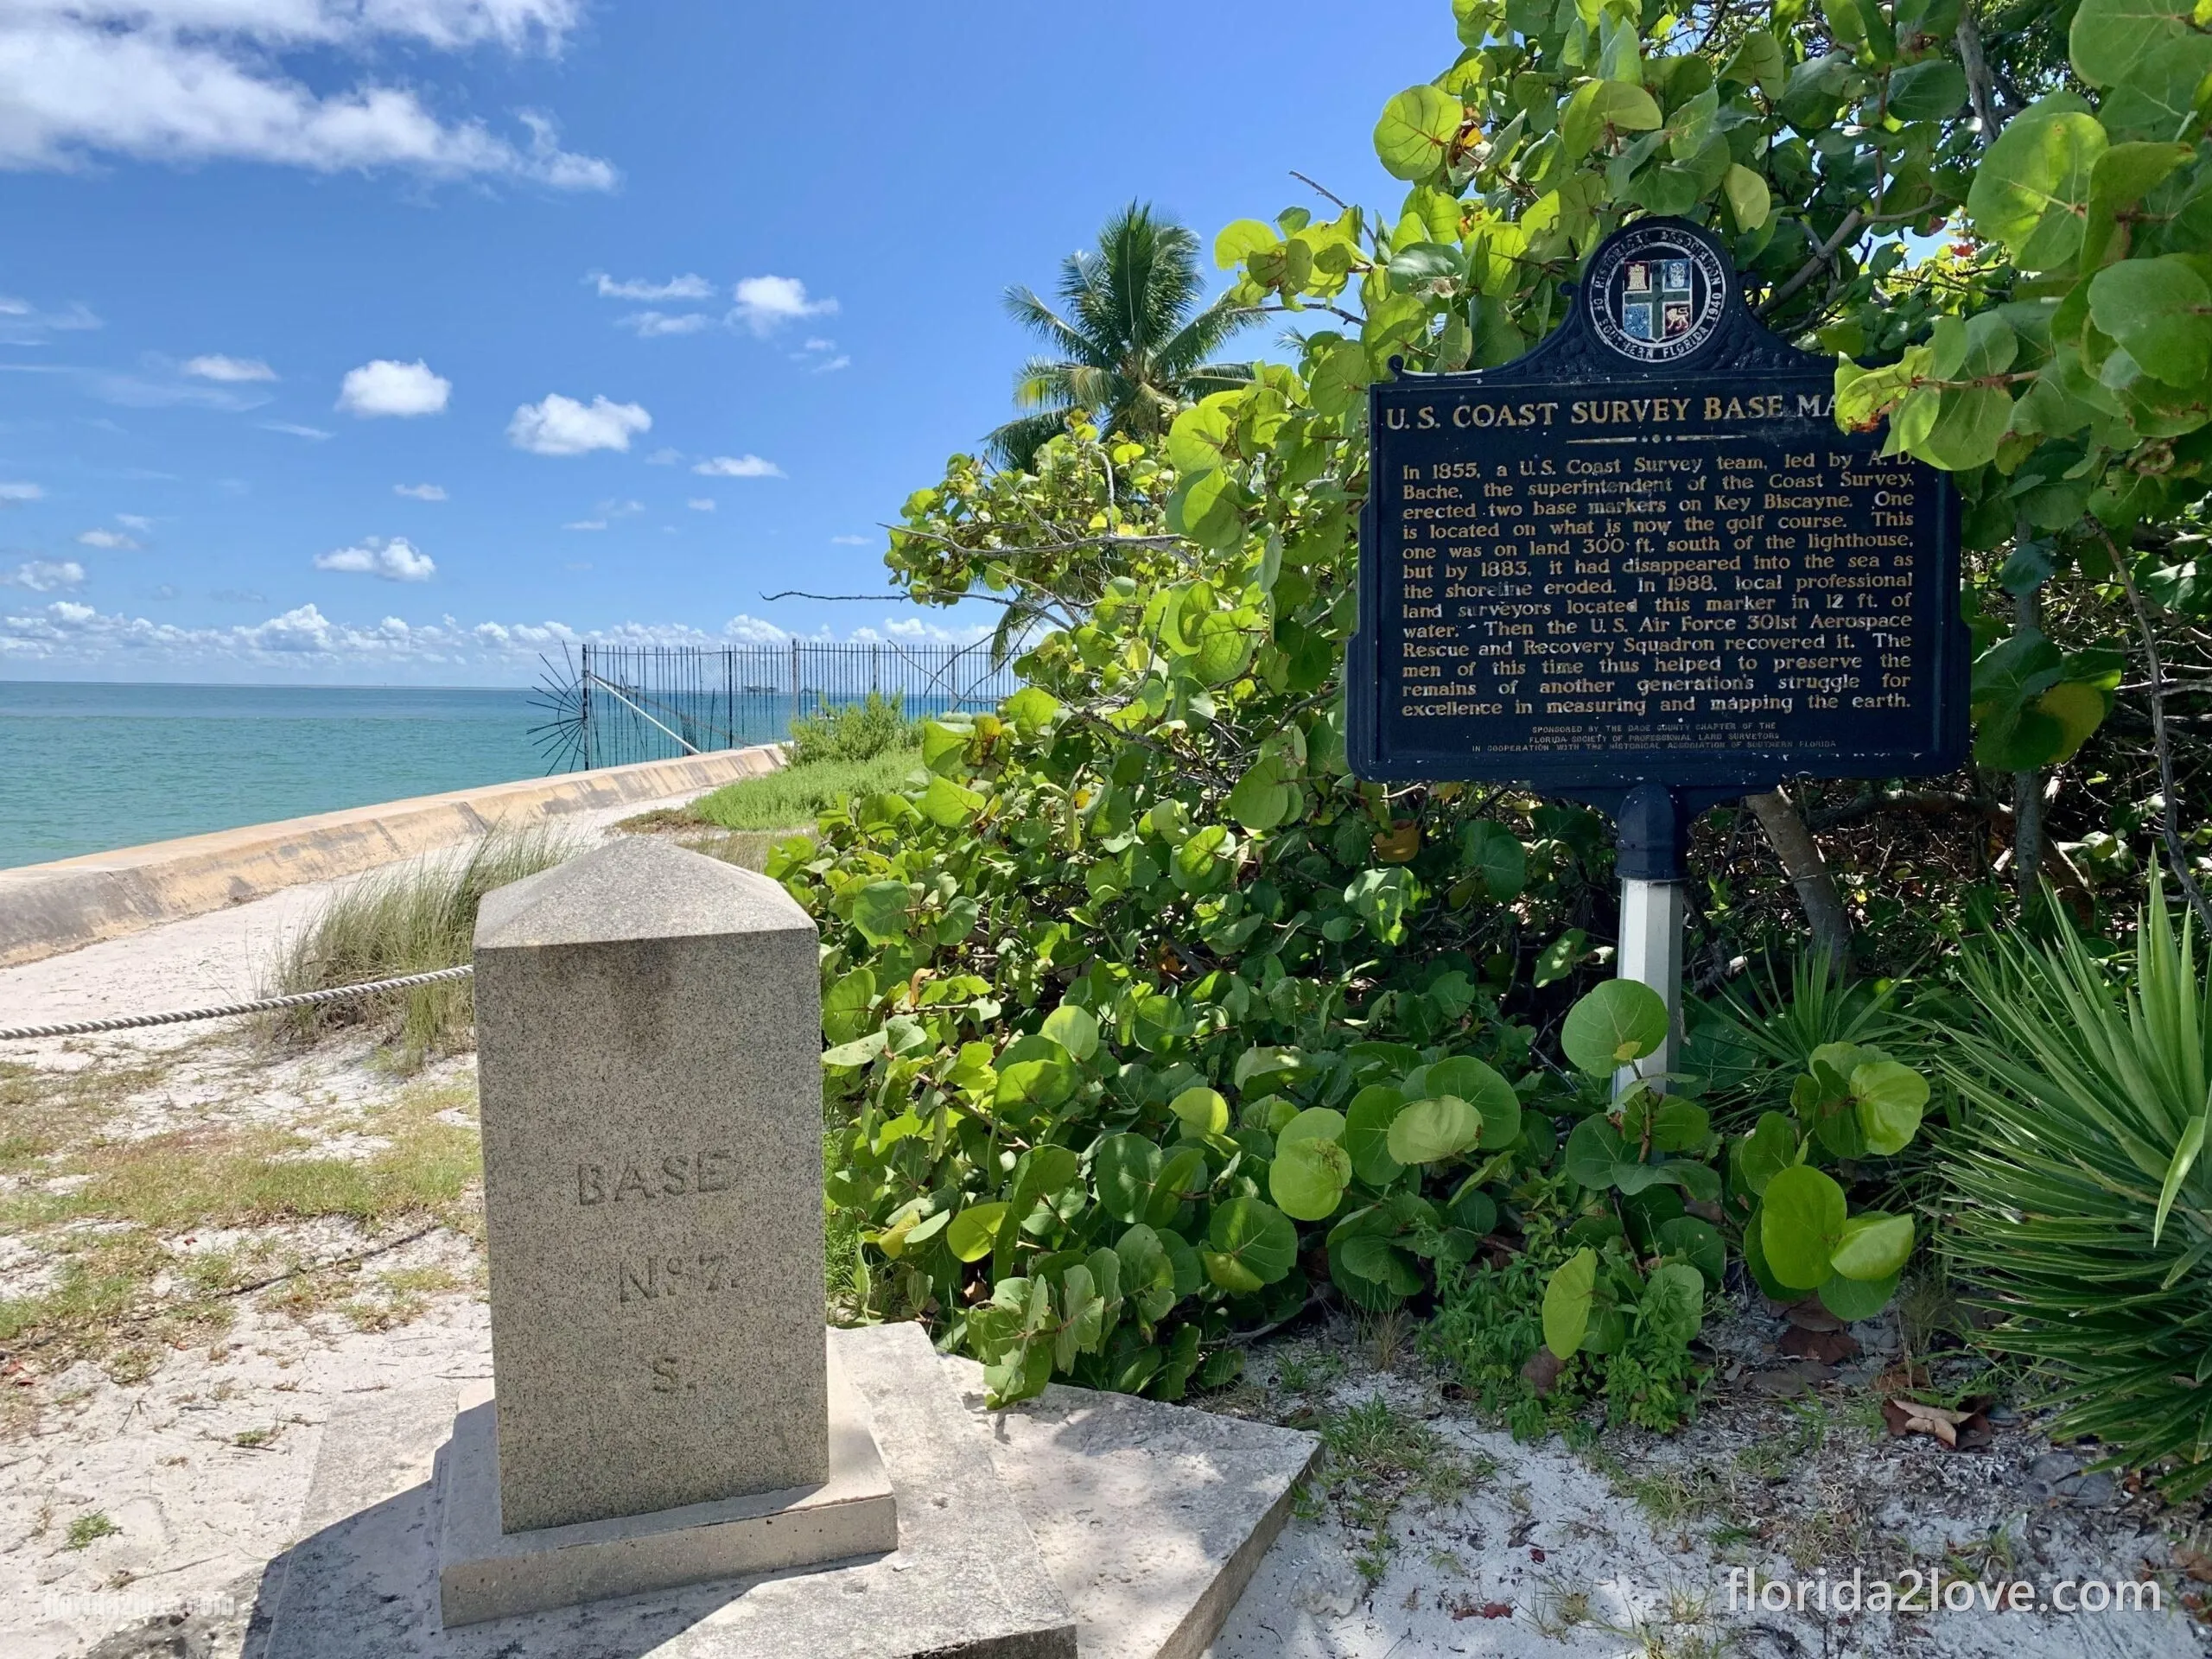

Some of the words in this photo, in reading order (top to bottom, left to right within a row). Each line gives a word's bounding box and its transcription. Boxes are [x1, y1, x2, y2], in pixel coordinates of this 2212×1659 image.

[1593, 298, 1605, 312] OF
[1663, 327, 1709, 359] FLORIDA
[1706, 292, 1722, 322] 1940
[1452, 403, 1558, 428] COAST
[1571, 397, 1691, 424] SURVEY
[1704, 395, 1783, 420] BASE
[1403, 466, 1420, 480] In
[1433, 463, 1480, 480] 1855,
[1497, 467, 1507, 477] a
[1567, 460, 1621, 476] Coast
[1634, 458, 1702, 474] Survey
[1716, 457, 1767, 471] team,
[1785, 454, 1815, 469] led
[1829, 453, 1853, 470] by
[1403, 485, 1462, 500] Bache,
[1484, 484, 1513, 498] the
[1528, 479, 1672, 497] superintendent
[1688, 476, 1707, 492] of
[1722, 476, 1754, 491] the
[1770, 474, 1823, 489] Coast
[1840, 473, 1914, 488] Survey,
[1402, 504, 1476, 518] erected
[1489, 504, 1522, 518] two
[1533, 502, 1576, 517] base
[1588, 499, 1666, 515] markers
[1679, 500, 1701, 512] on
[1714, 496, 1751, 512] Key
[1764, 494, 1853, 512] Biscayne.
[1874, 492, 1914, 507] One
[1403, 525, 1417, 540] is
[1430, 524, 1499, 539] located
[1513, 525, 1535, 537] on
[1549, 520, 1594, 536] what
[1606, 519, 1621, 534] is
[1633, 522, 1672, 534] now
[1684, 517, 1714, 532] the
[1726, 516, 1764, 536] golf
[1777, 517, 1847, 530] course.
[1871, 512, 1913, 527] This
[1402, 549, 1436, 560] one
[1449, 548, 1481, 558] was
[1494, 546, 1516, 557] on
[1529, 541, 1570, 556] land
[1583, 538, 1624, 555] 300
[1636, 538, 1655, 555] ft.
[1667, 537, 1719, 553] south
[1733, 536, 1753, 551] of
[1766, 536, 1796, 550] the
[1808, 534, 1913, 553] lighthouse,
[1403, 565, 1433, 580] but
[1446, 564, 1467, 582] by
[1482, 562, 1531, 577] 1883,
[1549, 562, 1562, 575] it
[1575, 559, 1610, 575] had
[1622, 556, 1741, 576] disappeared
[1754, 556, 1790, 570] into
[1804, 555, 1834, 569] the
[1848, 557, 1879, 569] sea
[1894, 556, 1913, 567] as
[1403, 585, 1433, 600] the
[1446, 582, 1532, 599] shoreline
[1544, 580, 1617, 595] eroded.
[1638, 578, 1655, 594] In
[1669, 575, 1717, 593] 1988,
[1736, 575, 1782, 592] local
[1796, 573, 1912, 594] professional
[1403, 605, 1442, 619] land
[1459, 605, 1551, 619] surveyors
[1567, 599, 1637, 616] located
[1655, 598, 1690, 613] this
[1706, 596, 1776, 613] marker
[1792, 595, 1809, 609] in
[1827, 594, 1843, 609] 12
[1857, 594, 1878, 609] ft.
[1891, 593, 1912, 607] of
[1403, 626, 1459, 639] water.
[1484, 621, 1534, 637] Then
[1547, 620, 1577, 636] the
[1638, 618, 1669, 633] Air
[1681, 617, 1736, 632] Force
[1747, 615, 1796, 631] 301st
[1809, 614, 1912, 631] Aerospace
[1403, 643, 1469, 658] Rescue
[1478, 641, 1512, 657] and
[1523, 640, 1614, 657] Recovery
[1624, 638, 1714, 654] Squadron
[1725, 635, 1825, 650] recovered
[1837, 634, 1854, 649] it.
[1872, 633, 1911, 649] The
[1402, 667, 1440, 678] men
[1458, 663, 1476, 677] of
[1492, 661, 1525, 676] this
[1541, 660, 1583, 675] time
[1599, 659, 1639, 674] thus
[1655, 657, 1720, 675] helped
[1738, 657, 1758, 671] to
[1774, 658, 1862, 674] preserve
[1880, 654, 1910, 669] the
[1403, 683, 1476, 697] remains
[1498, 681, 1518, 695] of
[1540, 679, 1615, 694] another
[1637, 674, 1753, 695] generation's
[1778, 675, 1859, 694] struggle
[1882, 674, 1910, 689] for
[1402, 702, 1502, 717] excellence
[1516, 700, 1532, 715] in
[1547, 699, 1646, 716] measuring
[1661, 697, 1694, 712] and
[1711, 696, 1793, 715] mapping
[1808, 695, 1838, 709] the
[1852, 694, 1910, 709] earth.
[577, 1149, 731, 1205] BASE
